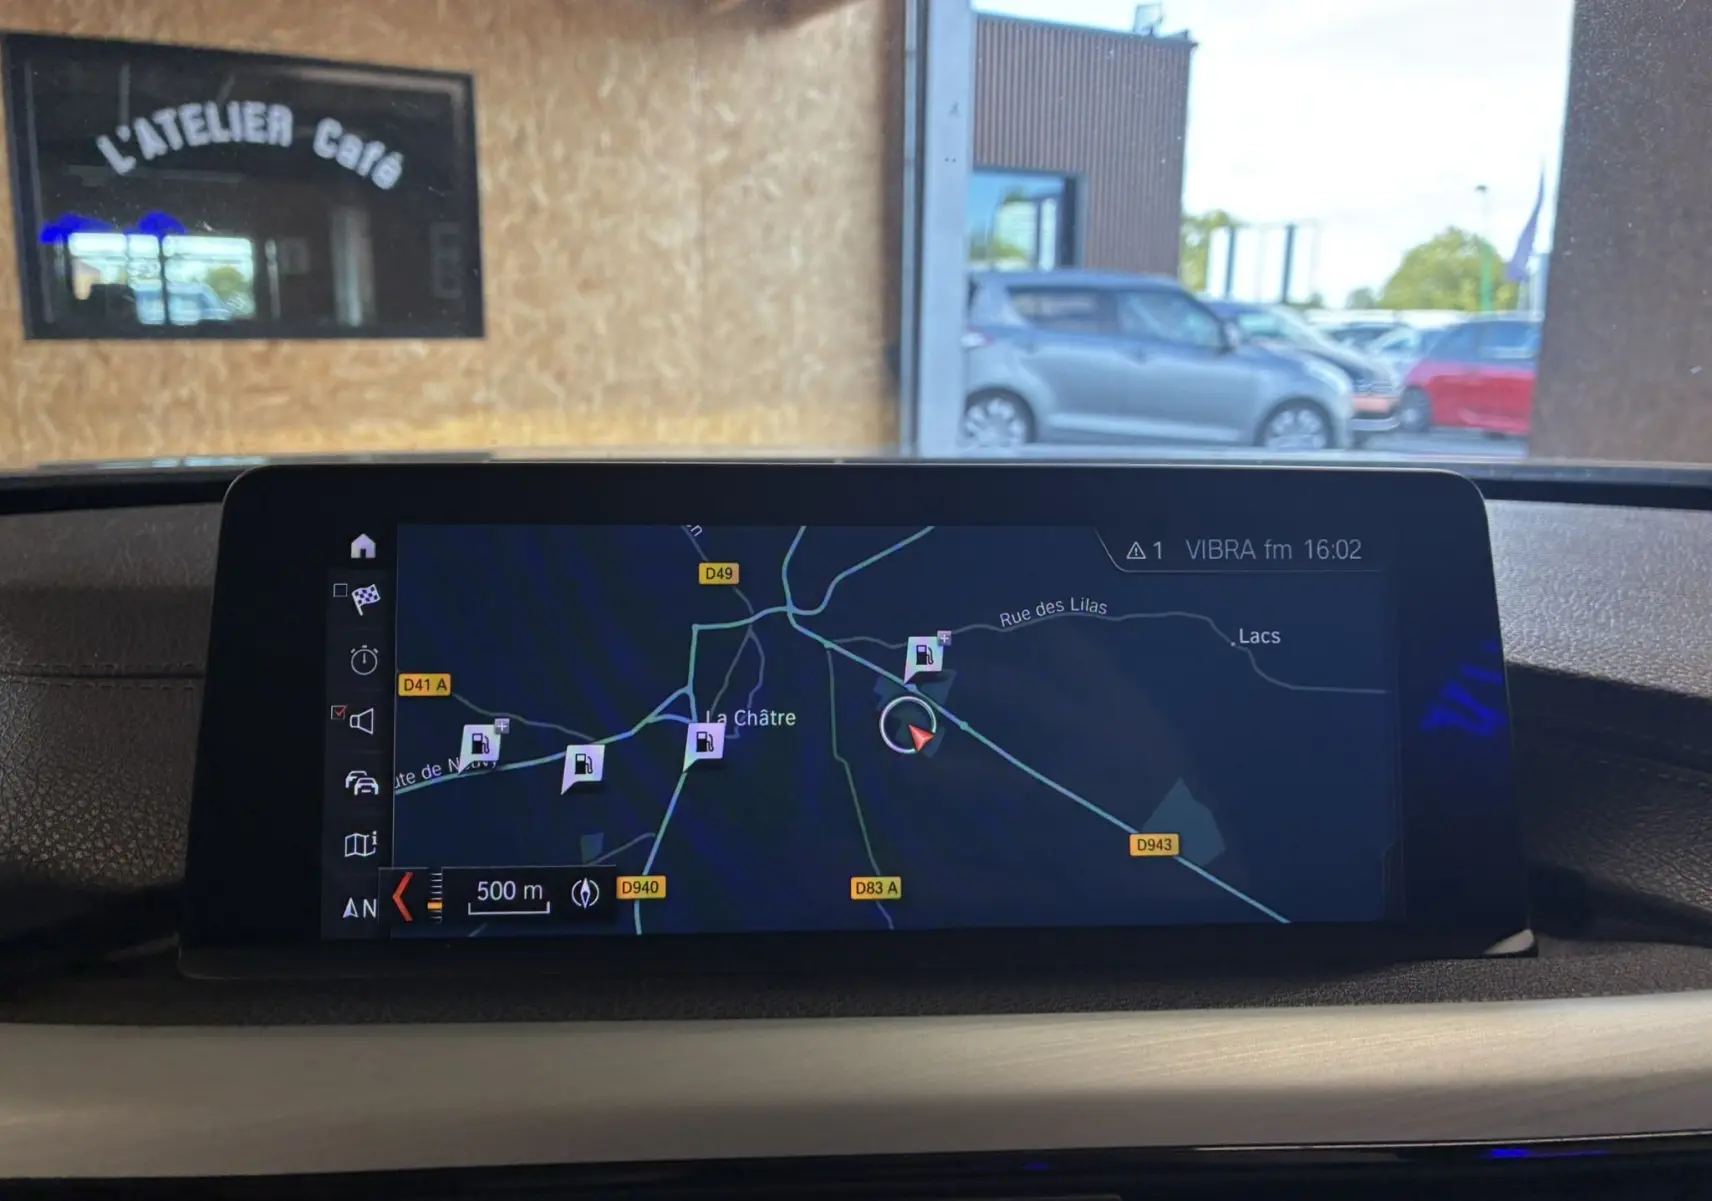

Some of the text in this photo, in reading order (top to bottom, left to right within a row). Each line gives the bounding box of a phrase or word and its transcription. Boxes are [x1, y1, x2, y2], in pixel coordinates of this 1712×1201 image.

[96, 100, 405, 191] L'ATELIER Café
[1185, 538, 1292, 560] VIBRA fm
[1304, 539, 1362, 560] 16:02
[705, 566, 733, 580] D49
[1000, 597, 1108, 627] Rue des Lilas
[1239, 628, 1281, 644] Lacs
[403, 677, 448, 693] D41 A
[706, 709, 797, 727] La Châtre
[421, 763, 442, 780] de
[1137, 838, 1172, 853] D943
[477, 881, 544, 900] 500 m
[622, 880, 660, 895] D940
[855, 881, 899, 896] D83 A
